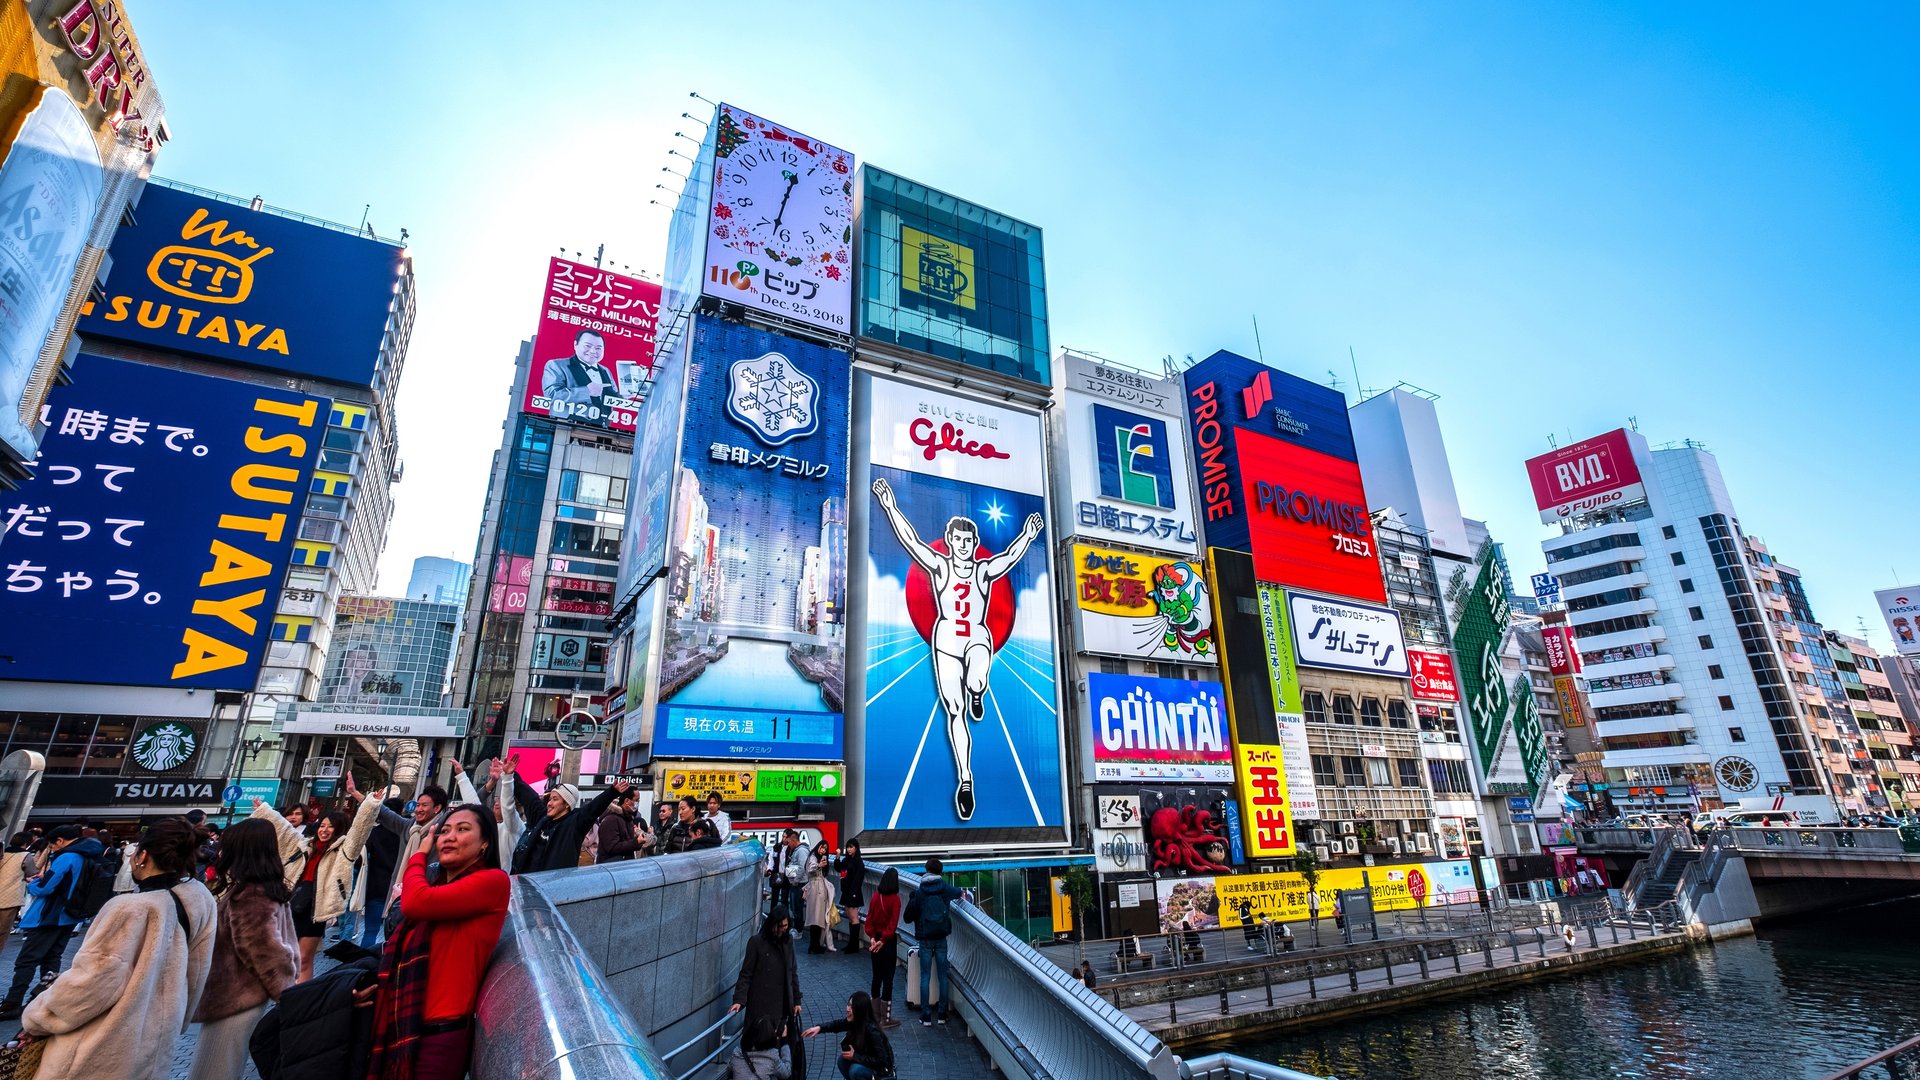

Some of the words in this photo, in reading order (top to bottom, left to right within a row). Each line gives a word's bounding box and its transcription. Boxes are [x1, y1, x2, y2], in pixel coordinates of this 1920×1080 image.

[102, 0, 145, 88] SUPER
[739, 154, 757, 171] 10
[759, 148, 776, 162] 11
[781, 151, 798, 168] 12
[732, 173, 748, 187] 9
[807, 167, 816, 177] 1
[737, 197, 754, 208] 8
[819, 186, 833, 196] 2
[756, 217, 771, 228] 7
[825, 206, 839, 218] 3
[0, 184, 71, 294] Asahi
[779, 229, 791, 243] 6
[803, 231, 815, 245] 5
[820, 222, 832, 235] 4
[554, 262, 633, 291] スーパー
[922, 260, 952, 279] 7-8F
[764, 268, 820, 300] ピップ
[549, 296, 597, 315] SUPER
[601, 310, 651, 330] MILLION
[760, 292, 790, 310] Dec.
[792, 302, 811, 318] 25,
[814, 308, 844, 326] 2018
[82, 295, 290, 355] SUTAYA
[1094, 365, 1153, 390] 夢ある住まい
[1086, 380, 1165, 410] エステムシリーズ
[918, 401, 999, 431] おいしさと健康
[1275, 406, 1292, 418] SMBC
[1276, 413, 1310, 432] CONSUMER
[909, 417, 1011, 461] Glico
[1277, 421, 1305, 437] FINANCE
[710, 442, 829, 478] 雪印メグミルク
[1192, 381, 1233, 523] PROMISE
[1557, 449, 1573, 458] Since
[28, 451, 136, 493] って
[1555, 453, 1610, 493] B.V.D.
[1257, 480, 1368, 536] PROMISE
[1573, 491, 1623, 512] FUJIBO
[6, 503, 145, 547] だって
[1079, 501, 1198, 543] 日商エステム
[171, 398, 319, 680] TSUTAYA
[1333, 533, 1372, 558] プロミス
[1087, 551, 1140, 576] かぜに
[6, 559, 162, 605] ちゃう。
[1081, 573, 1149, 608] 改源
[1485, 563, 1504, 606] エイブル
[953, 581, 973, 638] グリコ
[1311, 604, 1386, 624] 総合不動産のプロデューサー
[1261, 590, 1286, 709] 株式会社日本リート
[1325, 628, 1380, 656] サムティ
[1552, 635, 1566, 667] カラオケ
[1473, 651, 1502, 729] エイブル
[334, 723, 362, 732] EBISU
[683, 717, 755, 734] 現在の気温
[771, 716, 791, 740] 11
[1099, 686, 1223, 751] CHINTAI
[1520, 700, 1539, 751] エイブル
[729, 745, 772, 754] 雪印メグミルク
[1248, 750, 1277, 762] スーパー
[617, 776, 643, 785] Toilets
[1100, 767, 1121, 777] 天気予報
[114, 783, 213, 798] TSUTAYA
[1250, 766, 1289, 850] 玉出
[730, 830, 811, 849] OTTEA
[1408, 873, 1421, 885] TAX
